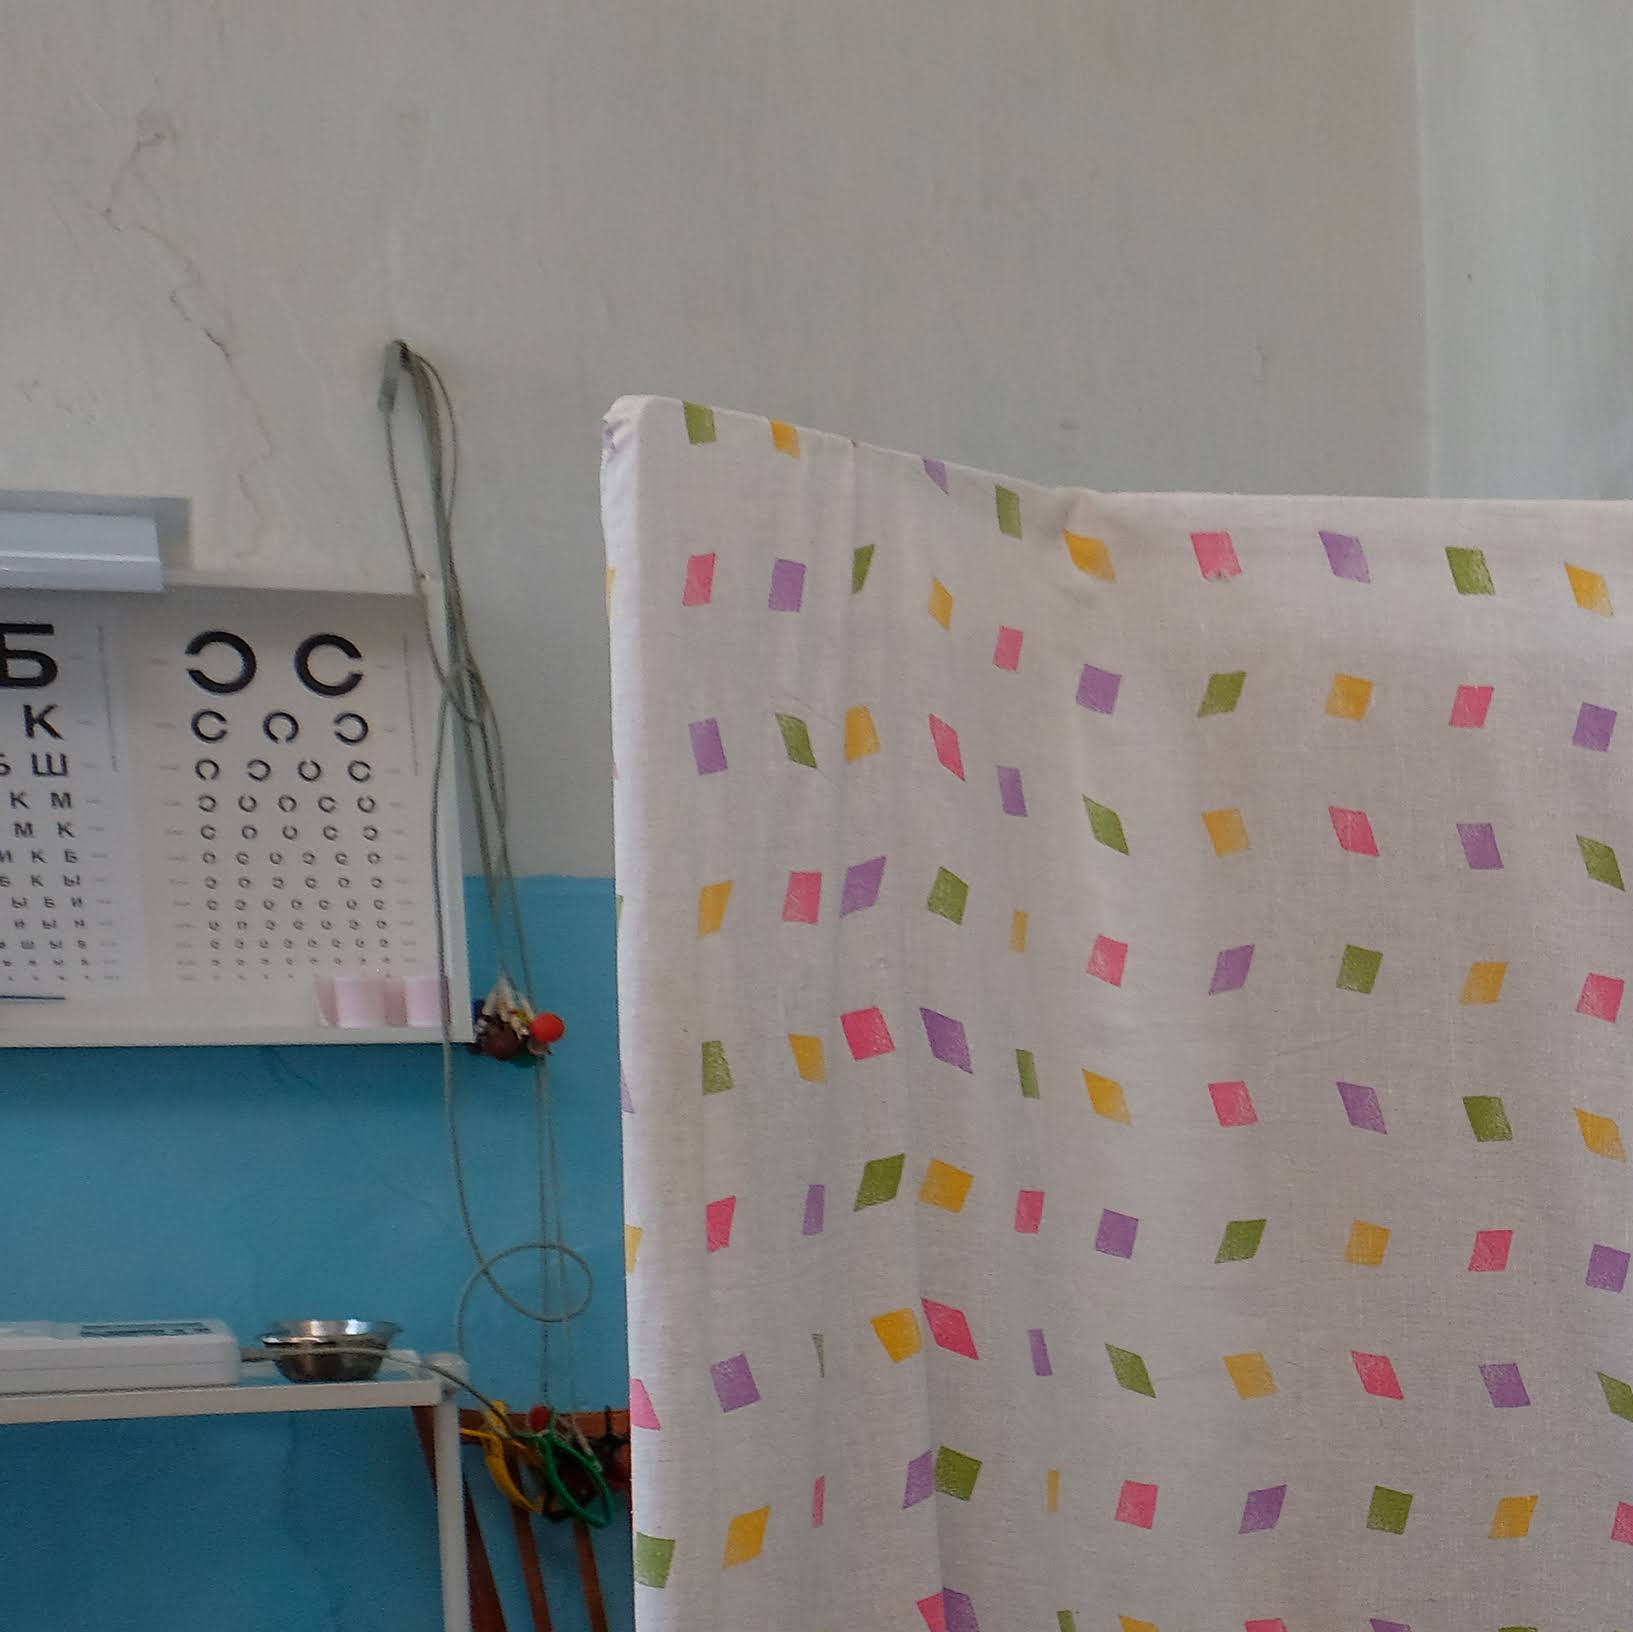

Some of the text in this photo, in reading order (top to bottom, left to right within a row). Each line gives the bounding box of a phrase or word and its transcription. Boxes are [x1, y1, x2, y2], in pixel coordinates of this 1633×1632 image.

[0, 623, 58, 689] Б
[23, 704, 64, 740] К
[31, 753, 70, 777] Ш
